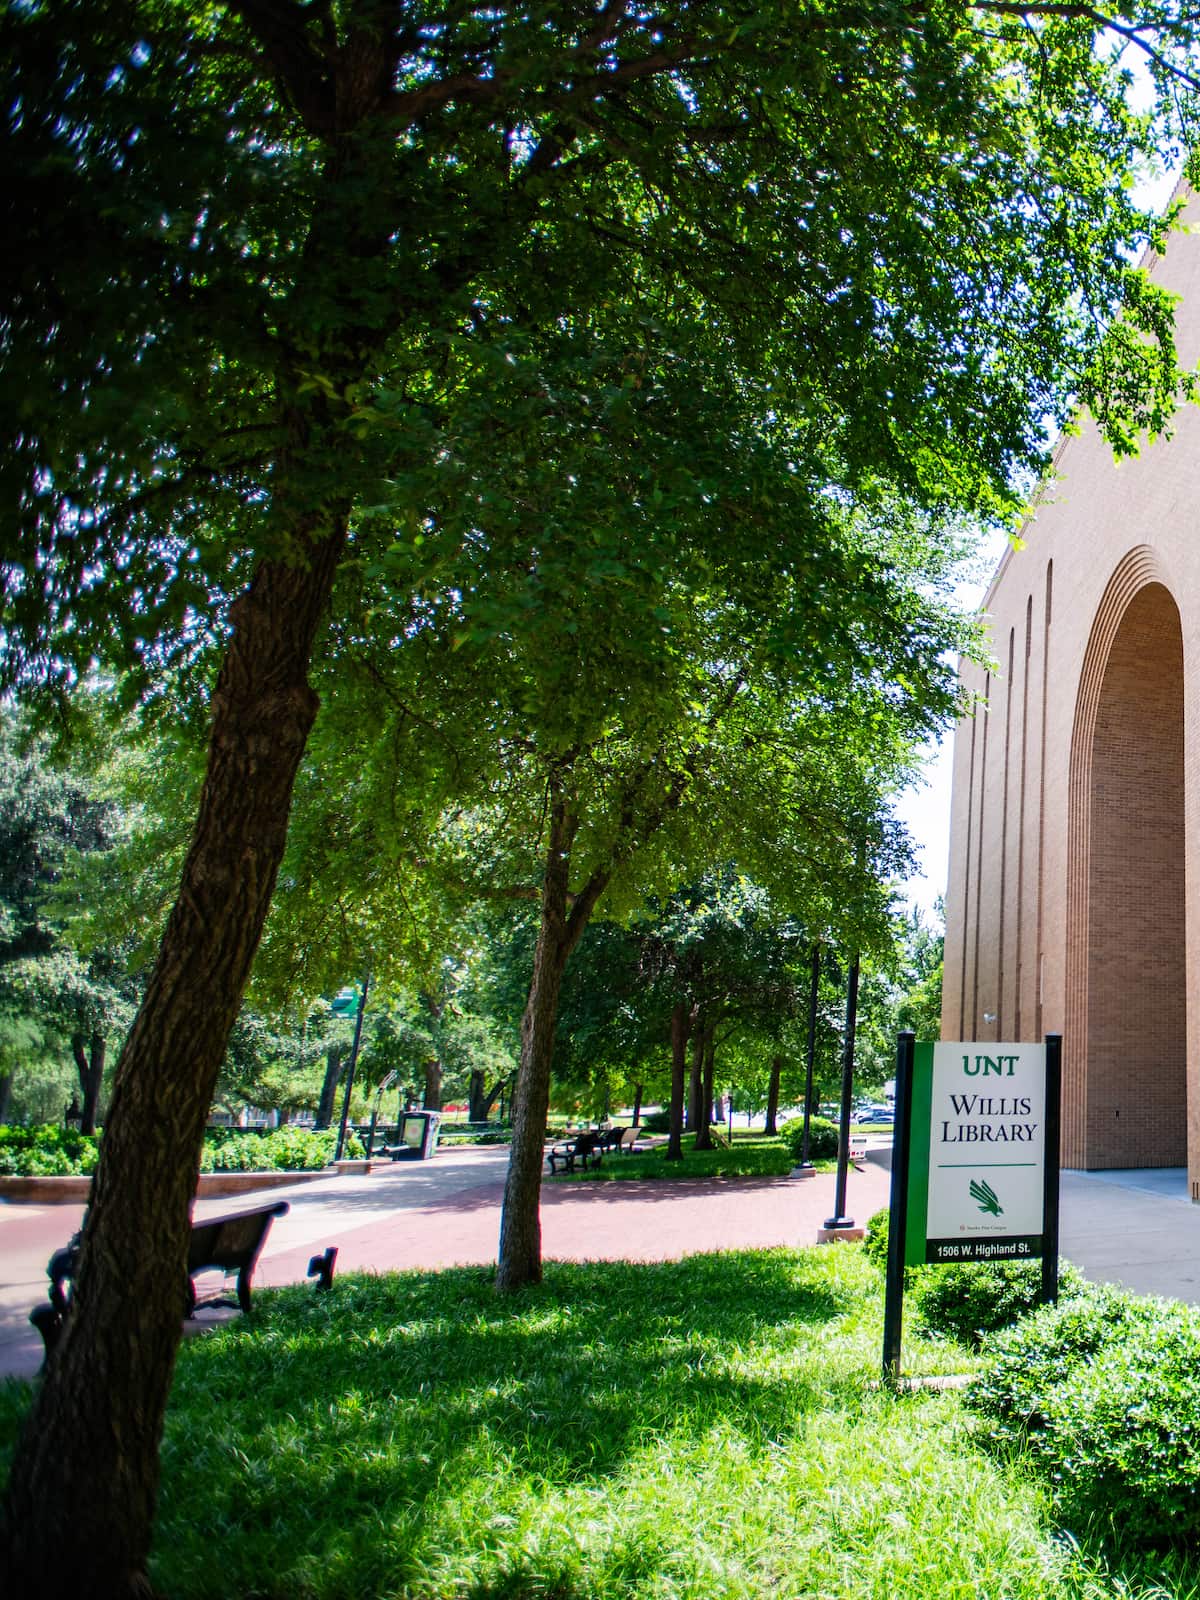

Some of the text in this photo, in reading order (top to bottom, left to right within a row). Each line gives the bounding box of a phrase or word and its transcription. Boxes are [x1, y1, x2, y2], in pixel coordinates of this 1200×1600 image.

[962, 1055, 1020, 1077] UNT
[949, 1094, 1032, 1116] WILLIS
[941, 1121, 1038, 1143] LIBRARY
[938, 1242, 1031, 1257] 1506 W. Highland St.
